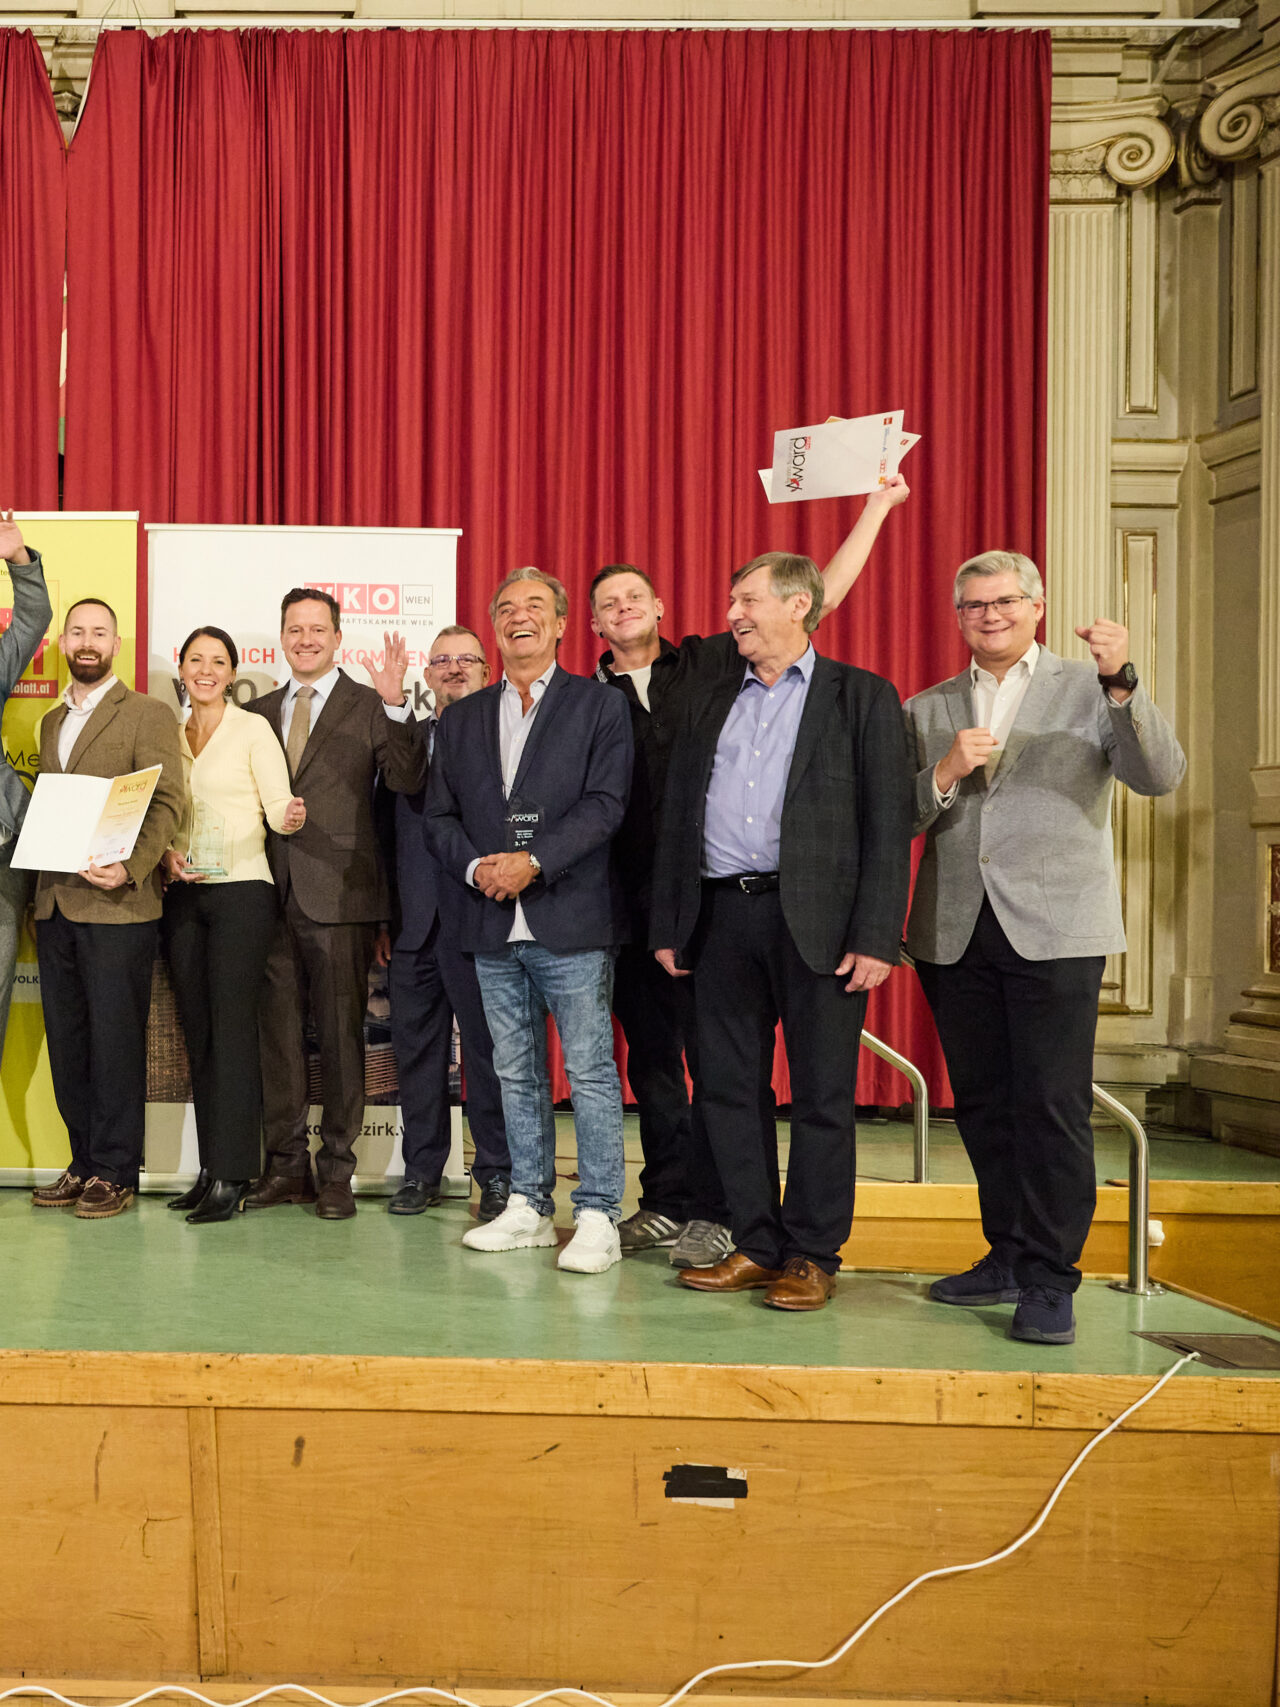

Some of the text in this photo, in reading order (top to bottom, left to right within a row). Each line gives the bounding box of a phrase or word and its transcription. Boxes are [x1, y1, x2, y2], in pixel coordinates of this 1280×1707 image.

[786, 436, 807, 492] Award
[306, 586, 431, 611] KO WIEN
[340, 618, 407, 626] HAFTSKAMMER
[5, 750, 41, 767] Me
[13, 975, 39, 984] VOLK
